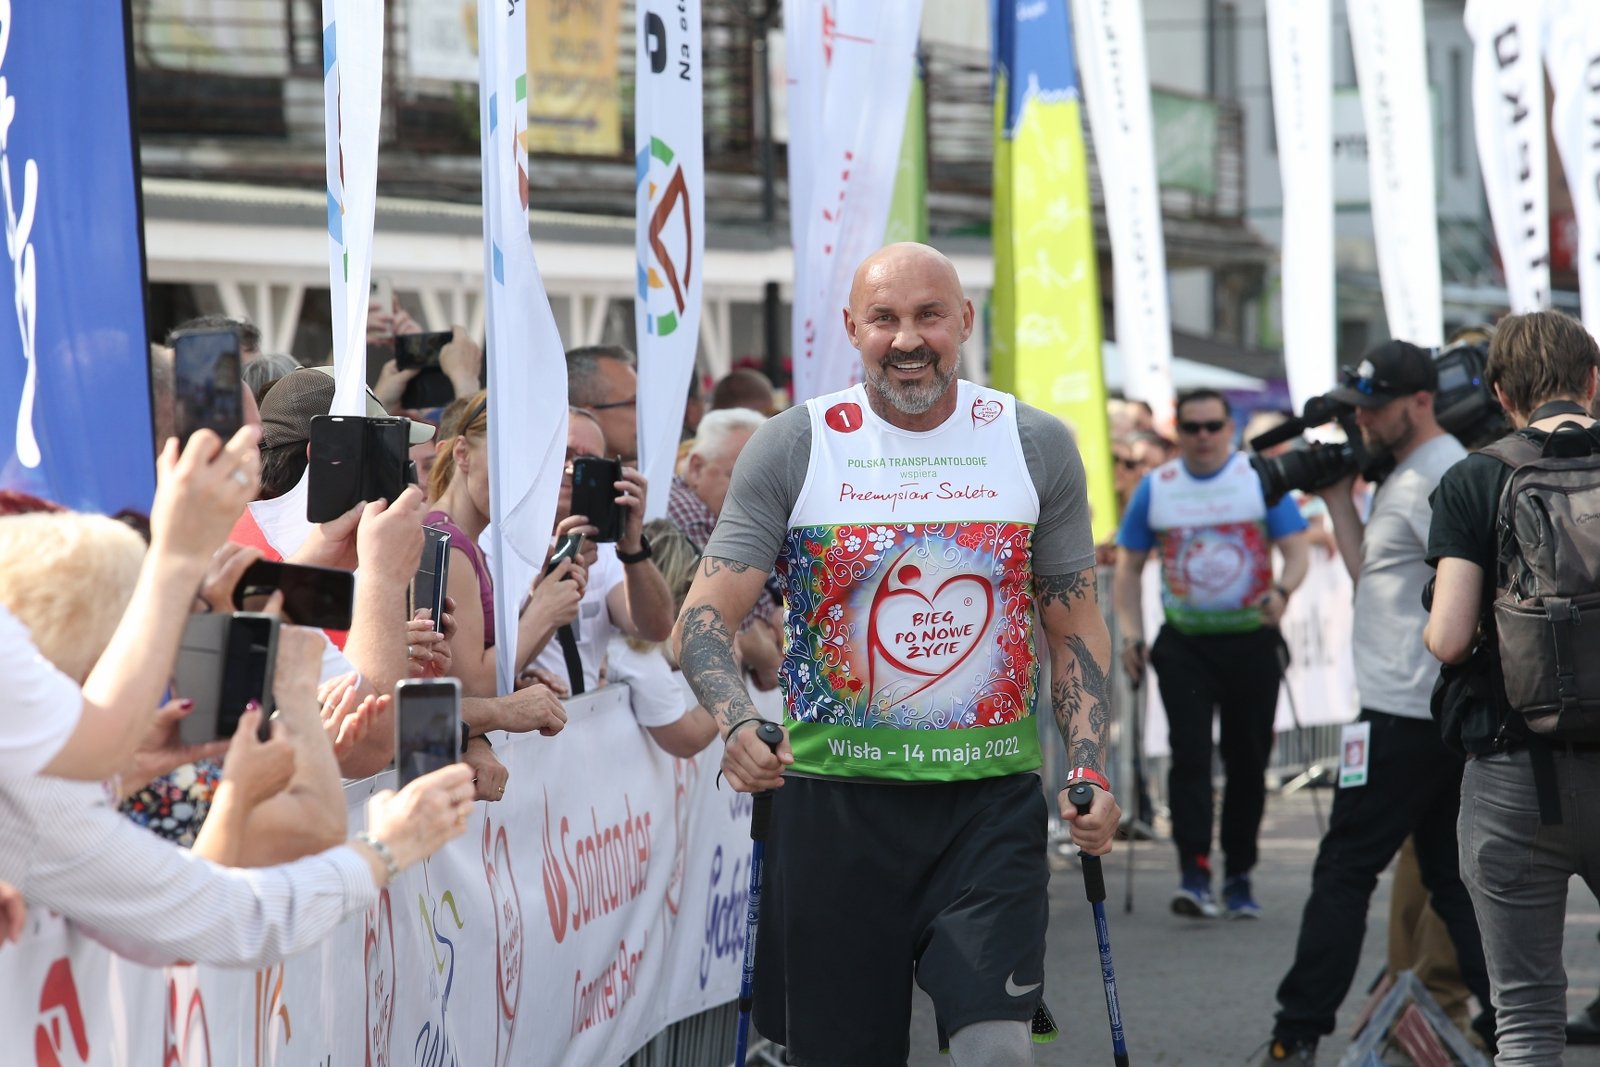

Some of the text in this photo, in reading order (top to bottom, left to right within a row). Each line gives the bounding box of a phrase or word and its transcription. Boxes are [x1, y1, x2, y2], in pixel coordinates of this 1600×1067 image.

[838, 409, 850, 428] 1
[848, 456, 988, 468] POLSKĄ TRANSPLANTOLOGIĘ
[900, 469, 937, 480] wspiera
[936, 482, 999, 500] Saleta
[912, 610, 955, 627] BIEG
[895, 623, 975, 645] PO NOWE
[906, 643, 961, 660] ŻYCIE
[827, 738, 882, 761] Wisła
[902, 743, 925, 762] 14
[931, 742, 981, 766] maja
[985, 735, 1020, 759] 2022
[560, 792, 652, 932] Santander
